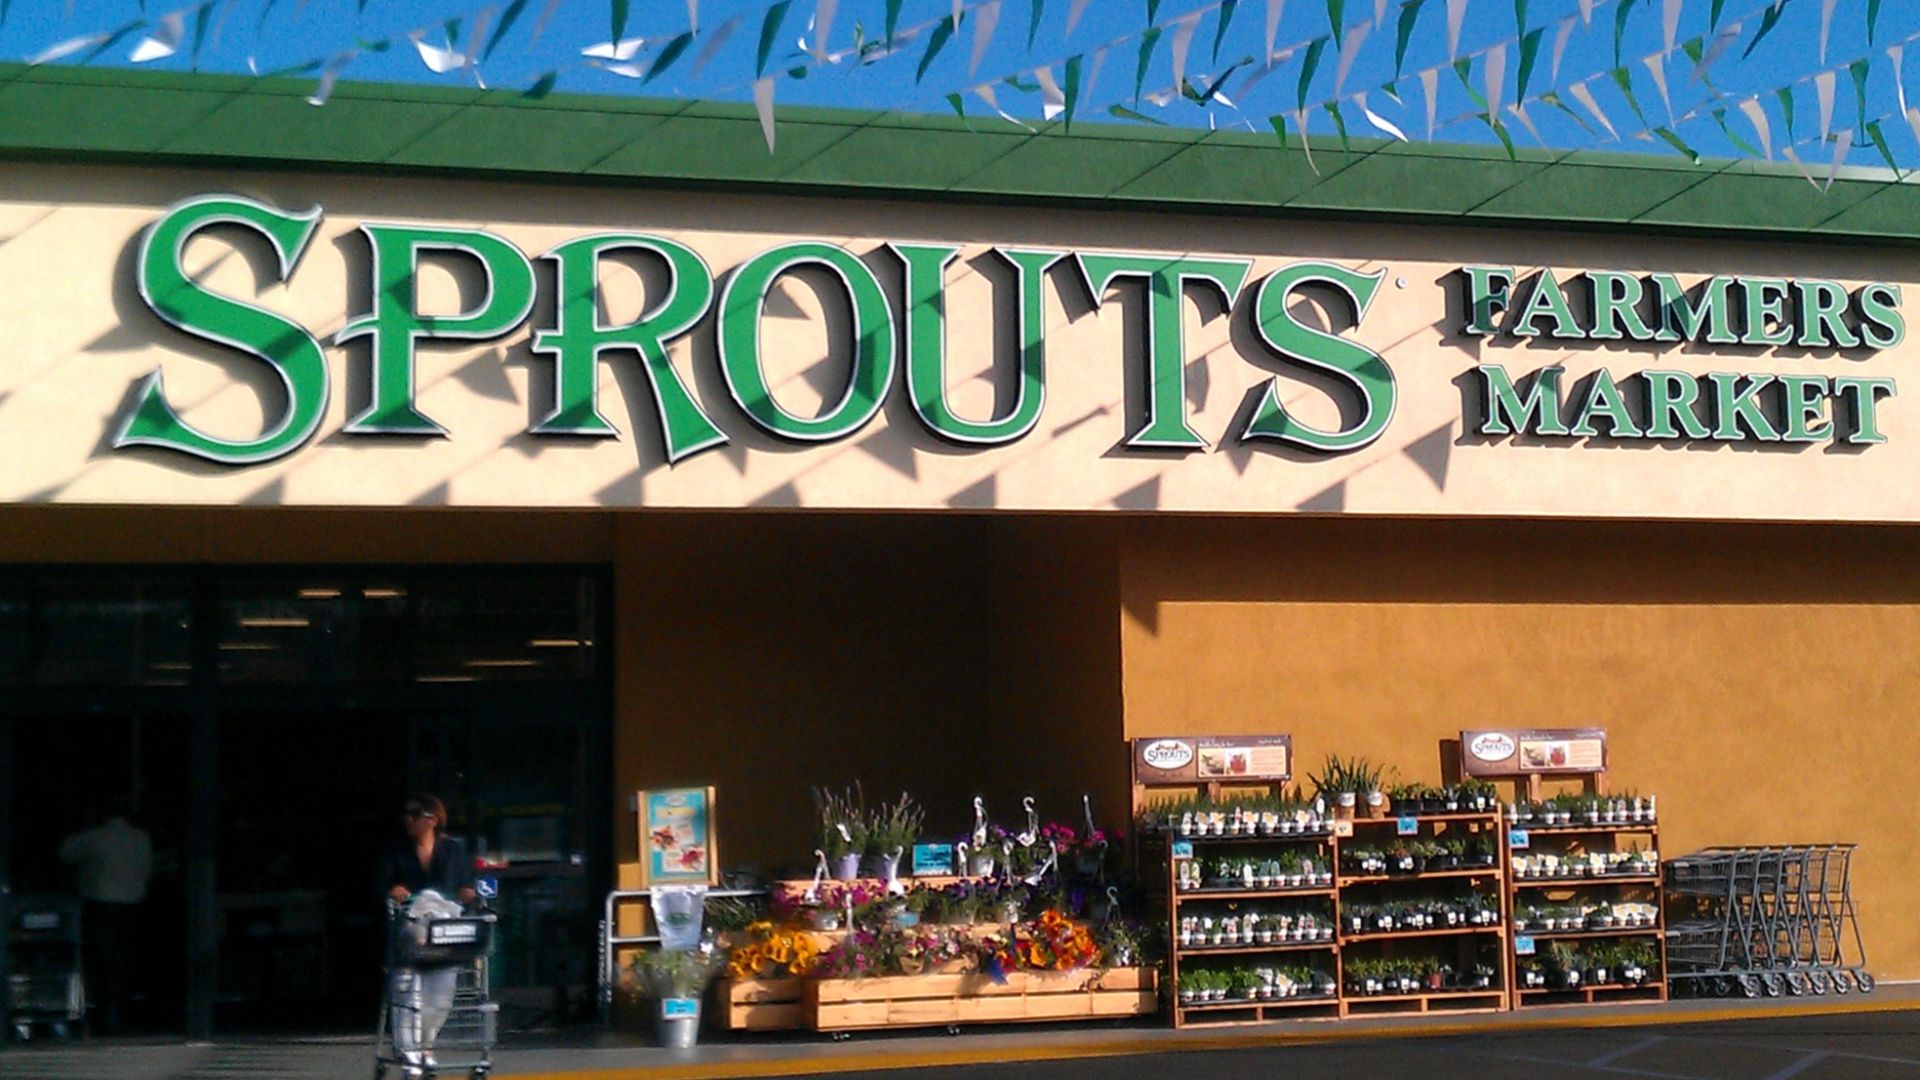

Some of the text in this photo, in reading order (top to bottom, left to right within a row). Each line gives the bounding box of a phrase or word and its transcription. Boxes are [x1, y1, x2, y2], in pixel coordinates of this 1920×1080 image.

[113, 194, 1398, 466] SPROUTS
[1462, 265, 1907, 349] FARMERS
[1478, 363, 1898, 444] MARKET
[1147, 748, 1190, 762] SPROUTS
